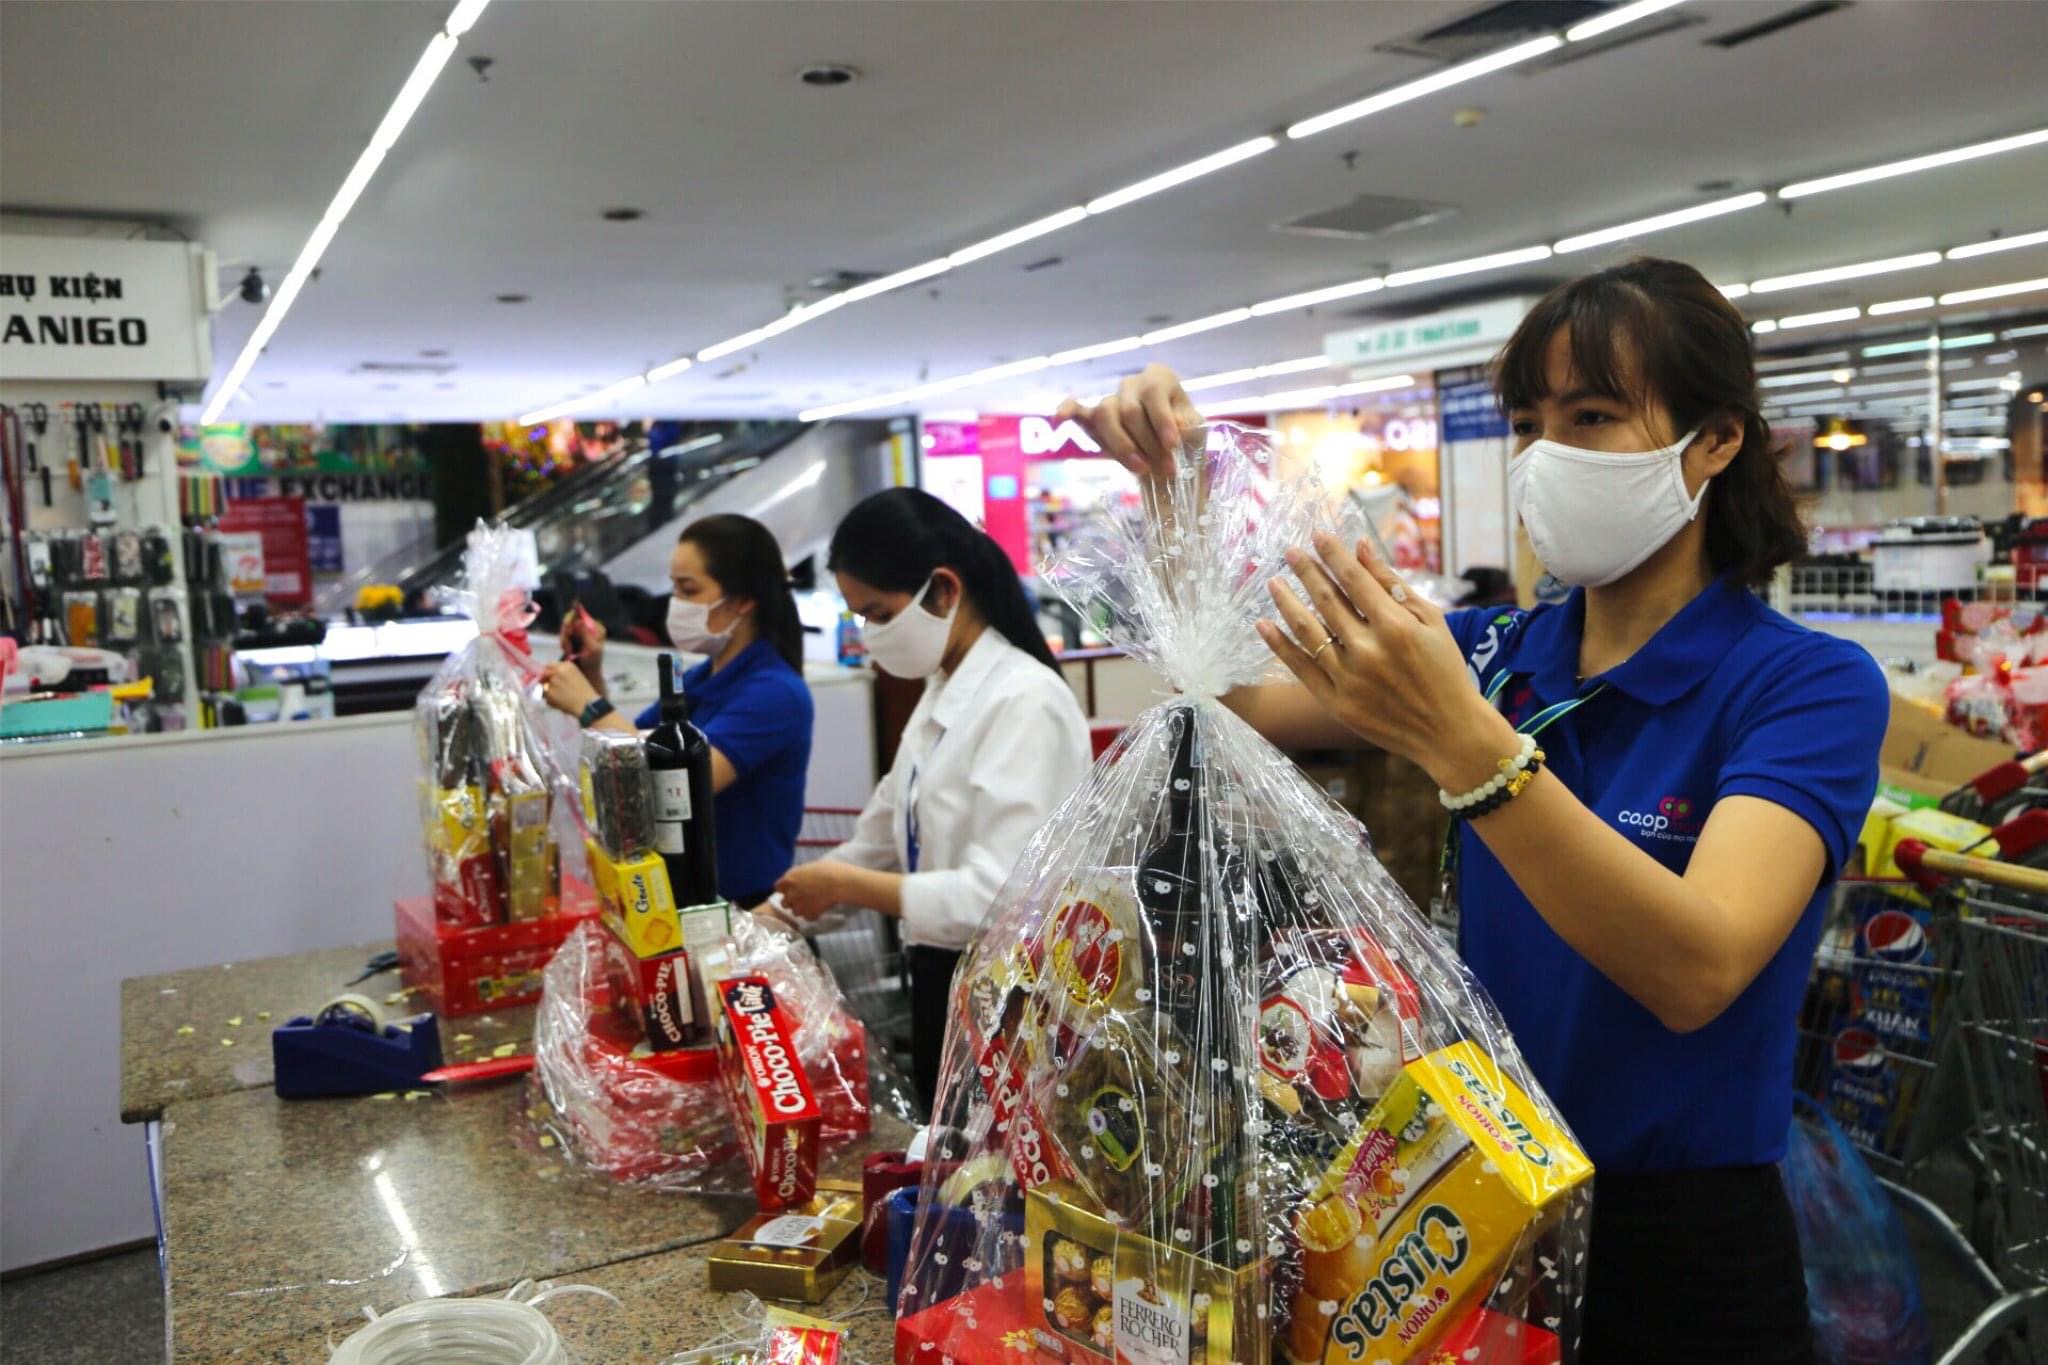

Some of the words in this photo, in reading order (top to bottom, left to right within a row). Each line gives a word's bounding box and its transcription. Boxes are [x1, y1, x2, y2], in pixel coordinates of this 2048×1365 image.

[49, 272, 123, 303] KIỆN
[278, 475, 433, 500] EXCHANGE
[1618, 810, 1668, 832] co.op
[1456, 1094, 1501, 1142] ORION
[1333, 1203, 1470, 1360] Custas
[1119, 1296, 1182, 1339] FERRERO
[1119, 1314, 1183, 1360] ROCHER
[1398, 1297, 1438, 1345] ORION
